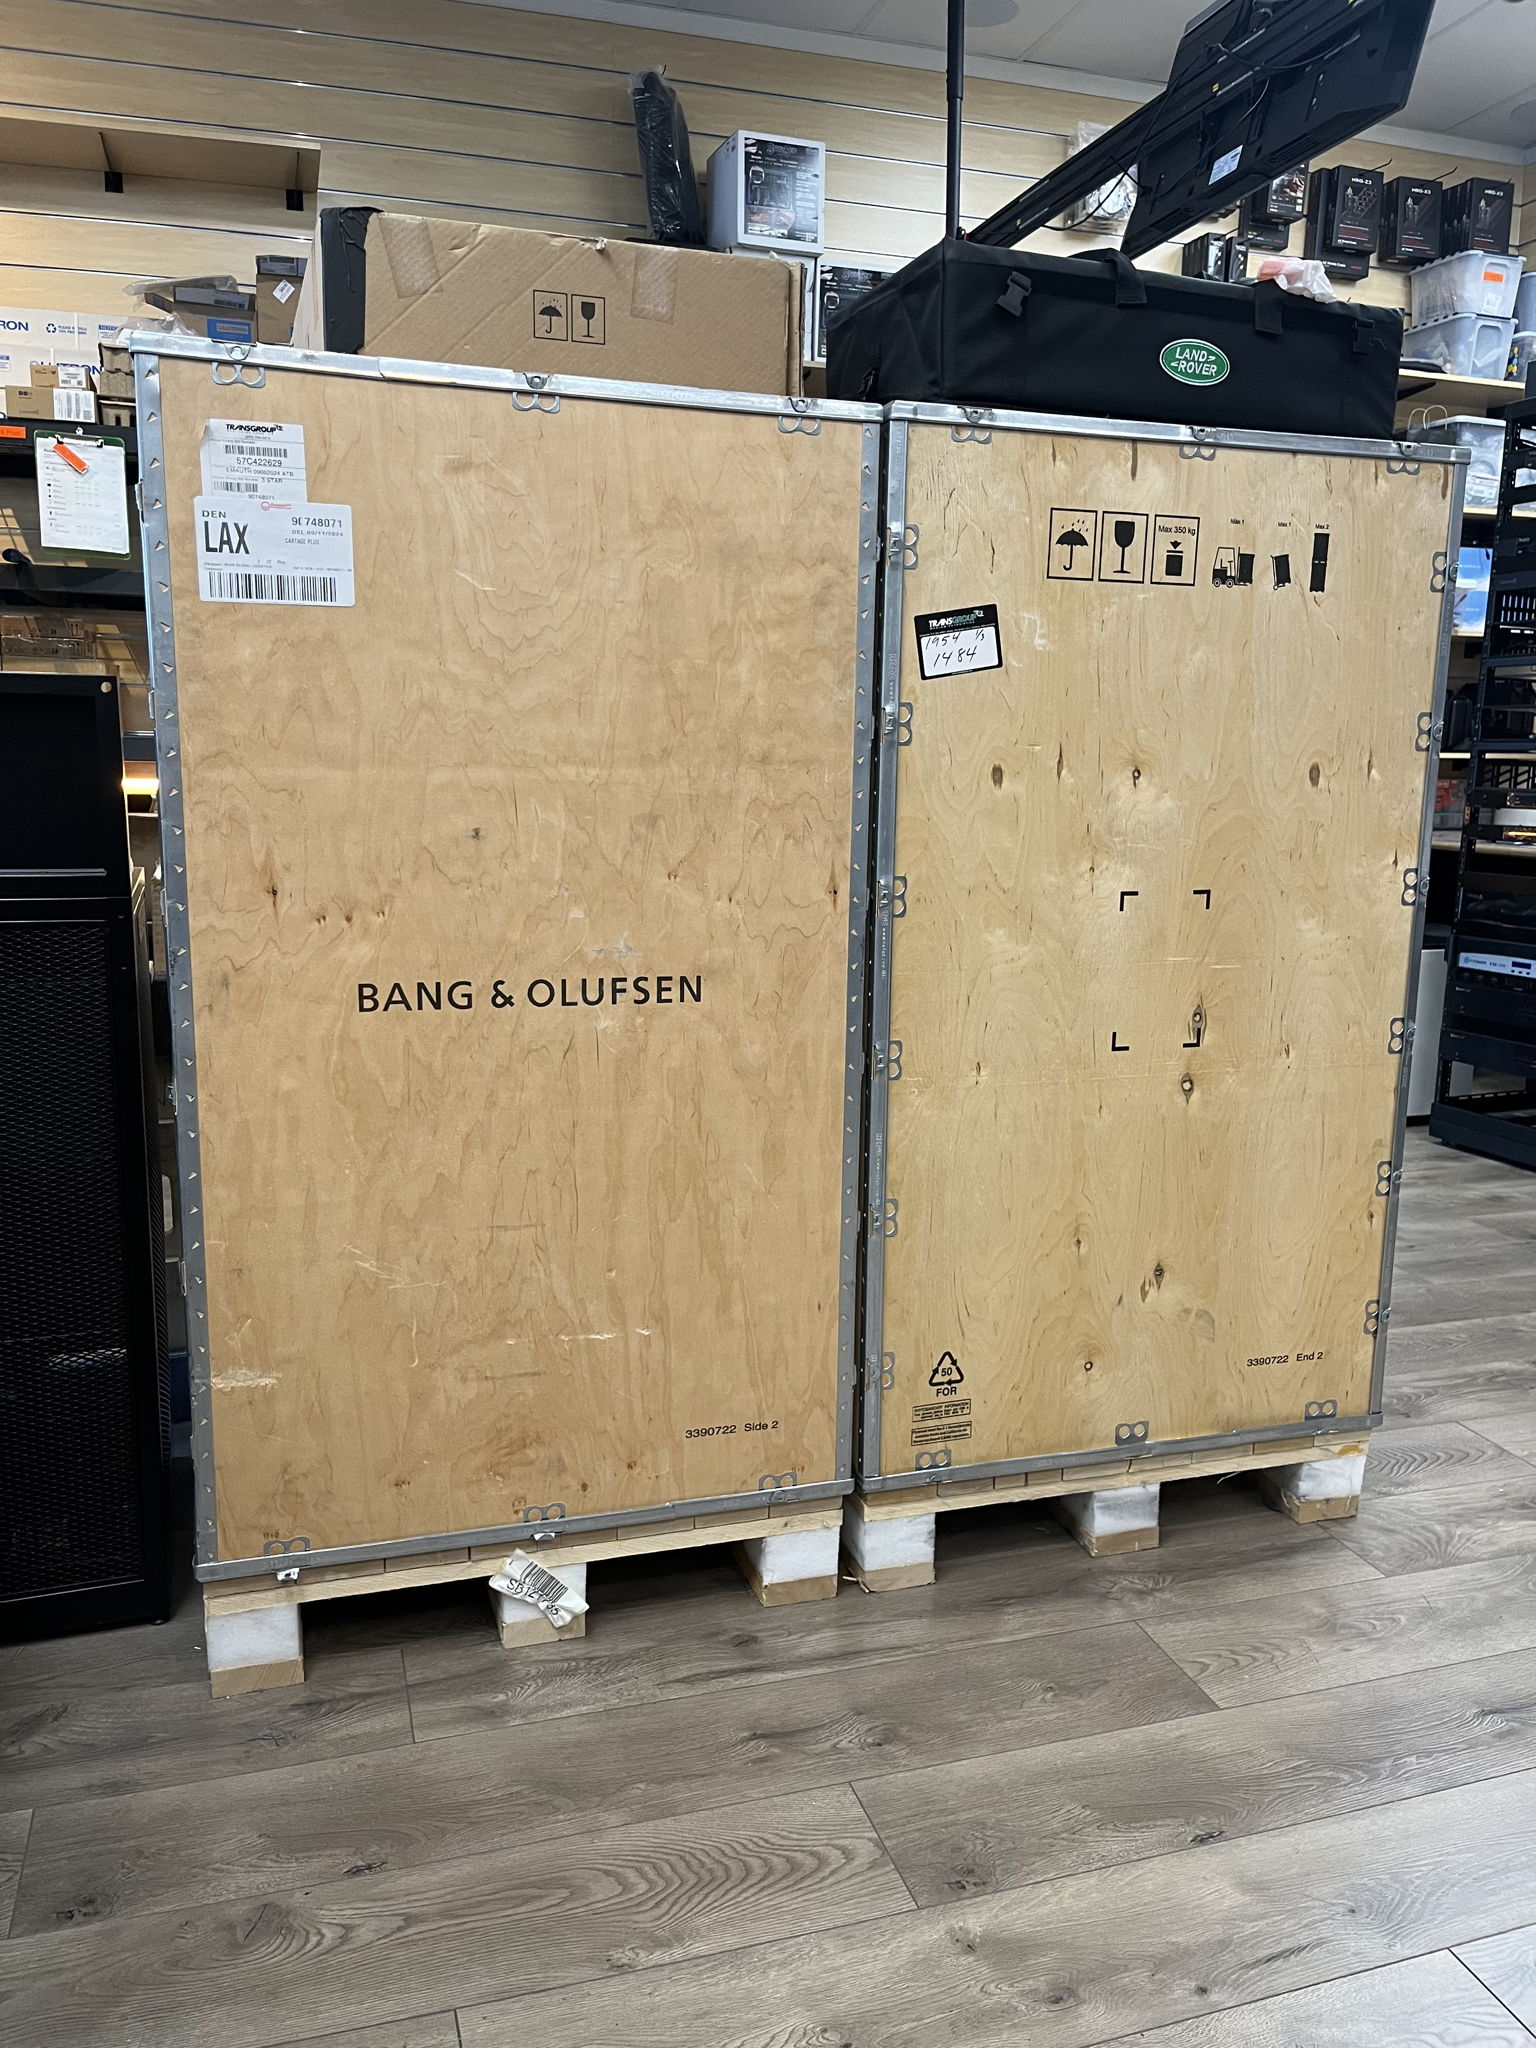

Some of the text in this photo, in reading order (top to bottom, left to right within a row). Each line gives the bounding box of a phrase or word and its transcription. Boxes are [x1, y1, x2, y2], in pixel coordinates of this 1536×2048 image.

[1175, 347, 1207, 362] LAND
[1178, 361, 1217, 376] ROVER
[226, 424, 276, 433] TRANSGROUP
[236, 457, 282, 467] 57C422629
[201, 510, 226, 518] DEN
[204, 520, 250, 555] LAX
[1158, 525, 1196, 536] Max 350 kg
[929, 613, 977, 628] TRANSGROUP
[933, 645, 977, 668] 1484
[357, 975, 702, 1013] BANG & OLUFSEN
[1246, 1351, 1324, 1367] 3390722 End 2
[941, 1367, 953, 1376] 50
[936, 1386, 957, 1398] FOR
[685, 1420, 779, 1439] 3390722 Side 2
